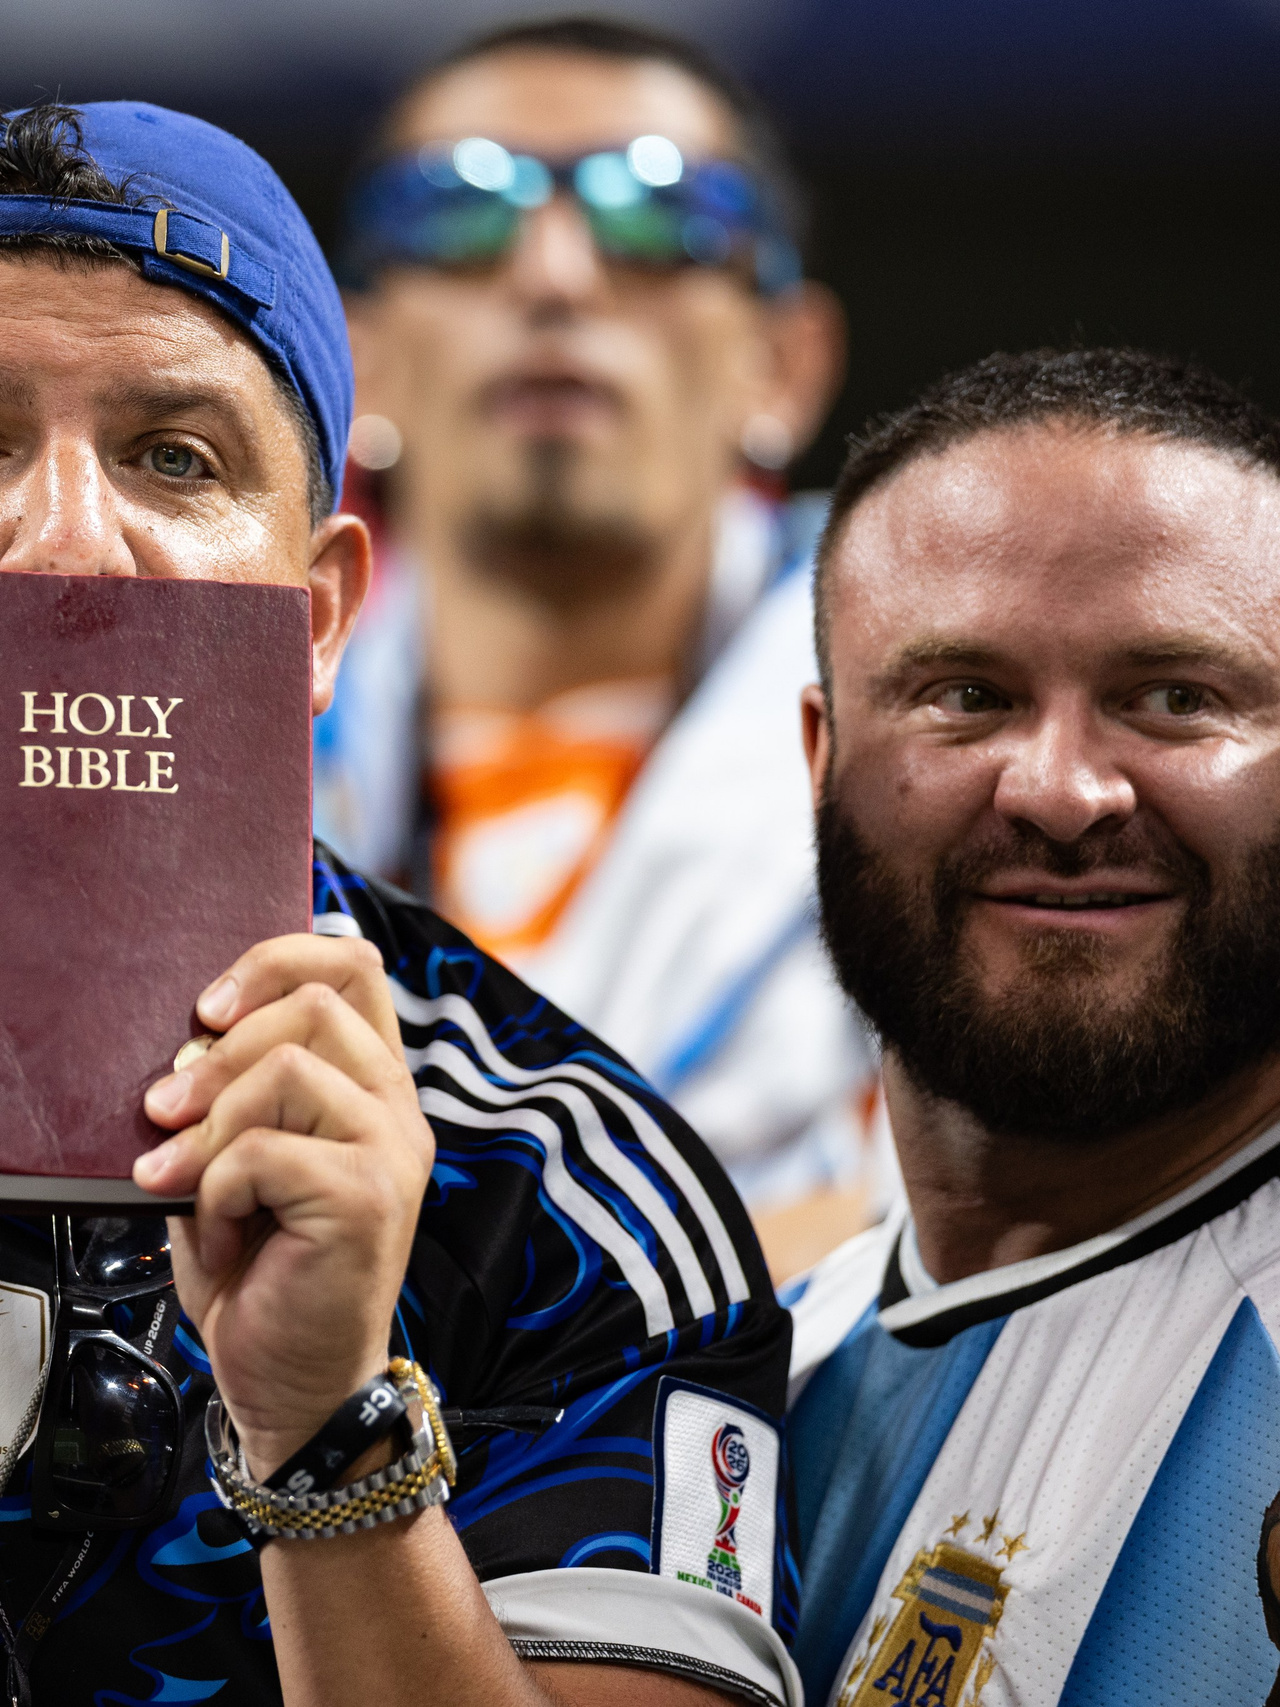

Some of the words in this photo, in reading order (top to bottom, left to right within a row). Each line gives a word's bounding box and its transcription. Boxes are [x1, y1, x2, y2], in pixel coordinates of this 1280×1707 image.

[20, 691, 183, 738] HOLY
[18, 745, 180, 793] BIBLE
[147, 1299, 166, 1341] 2026
[144, 1339, 154, 1355] UP
[52, 1580, 69, 1603] FIFA
[67, 1538, 91, 1578] WORLD
[707, 1559, 741, 1583] 2026
